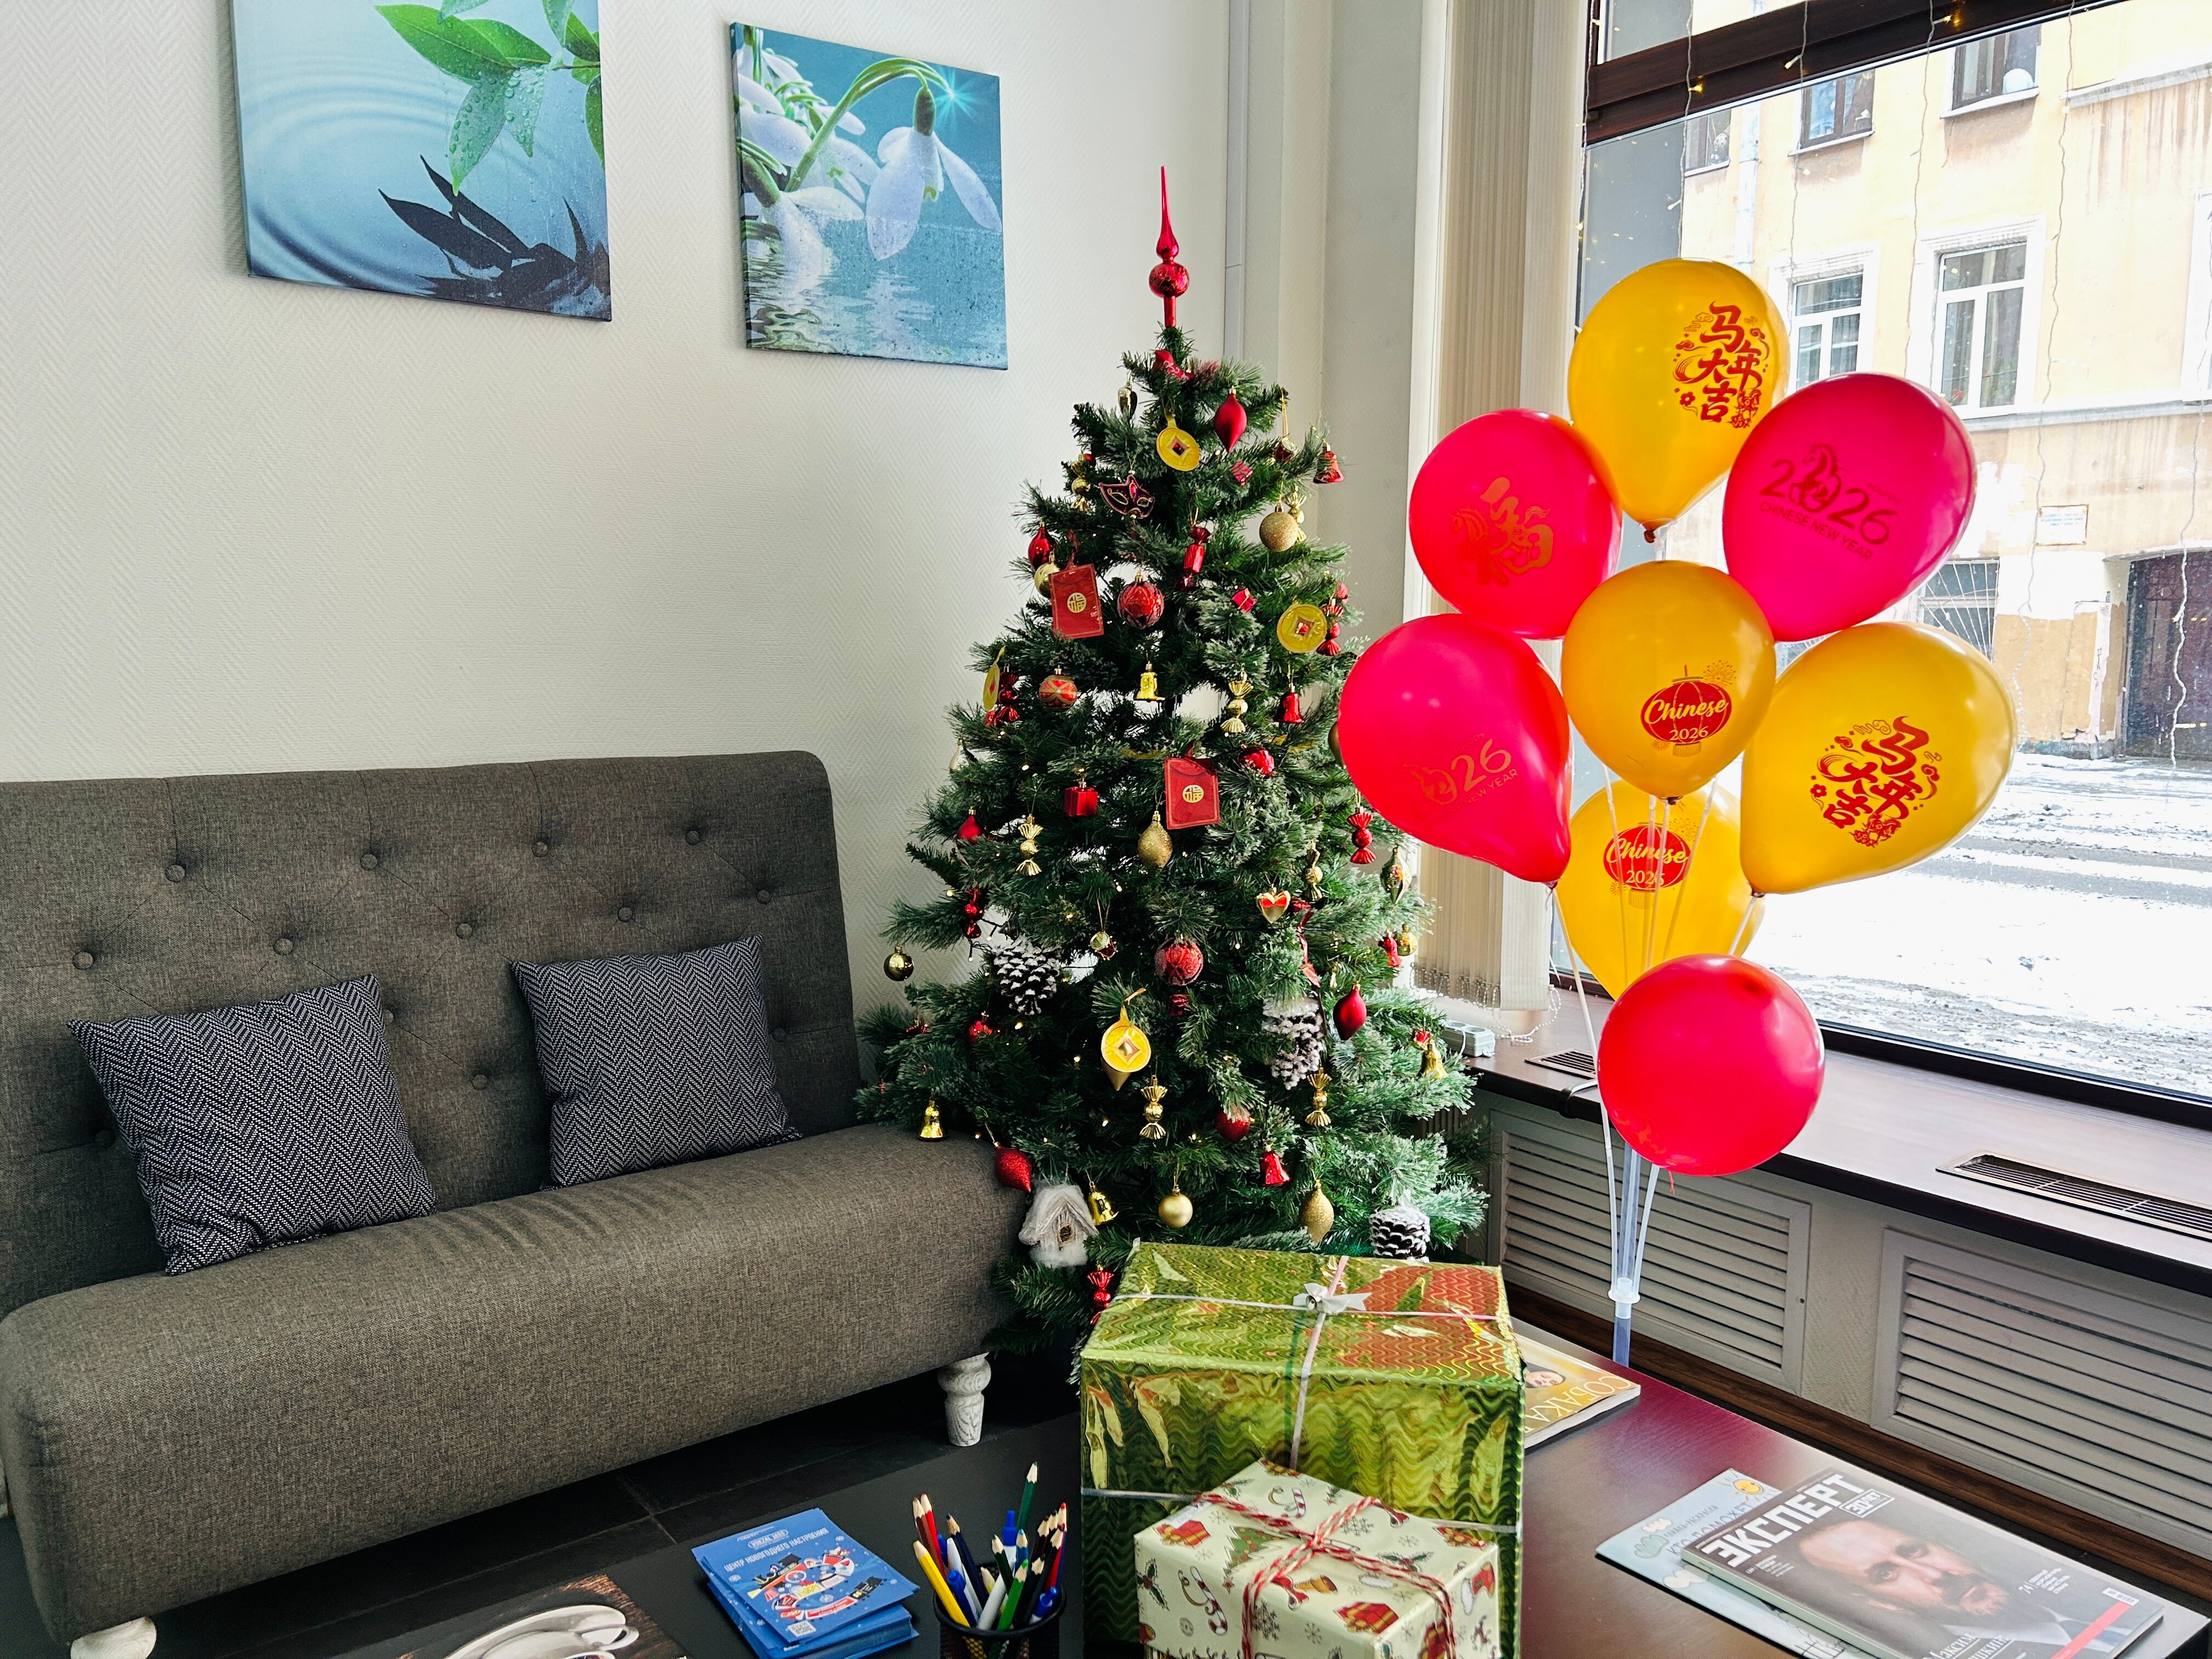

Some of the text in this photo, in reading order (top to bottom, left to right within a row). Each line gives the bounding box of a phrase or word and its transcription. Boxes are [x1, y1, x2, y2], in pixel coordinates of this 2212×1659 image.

[1759, 459, 1897, 545] 2026
[1759, 500, 1874, 561] CHINESE NEW YEAR
[1644, 698, 1729, 725] Chinese
[1668, 725, 1709, 741] 2026
[1487, 768, 1519, 790] YEAR
[1606, 838, 1690, 865] Chinese
[1701, 1474, 1864, 1567] ЭКСПЕРТ
[724, 1560, 744, 1572] ЦЕНТР
[745, 1543, 790, 1564] НОВОГОДНЕГО
[788, 1527, 830, 1547] НАСТРОЕНИЯ
